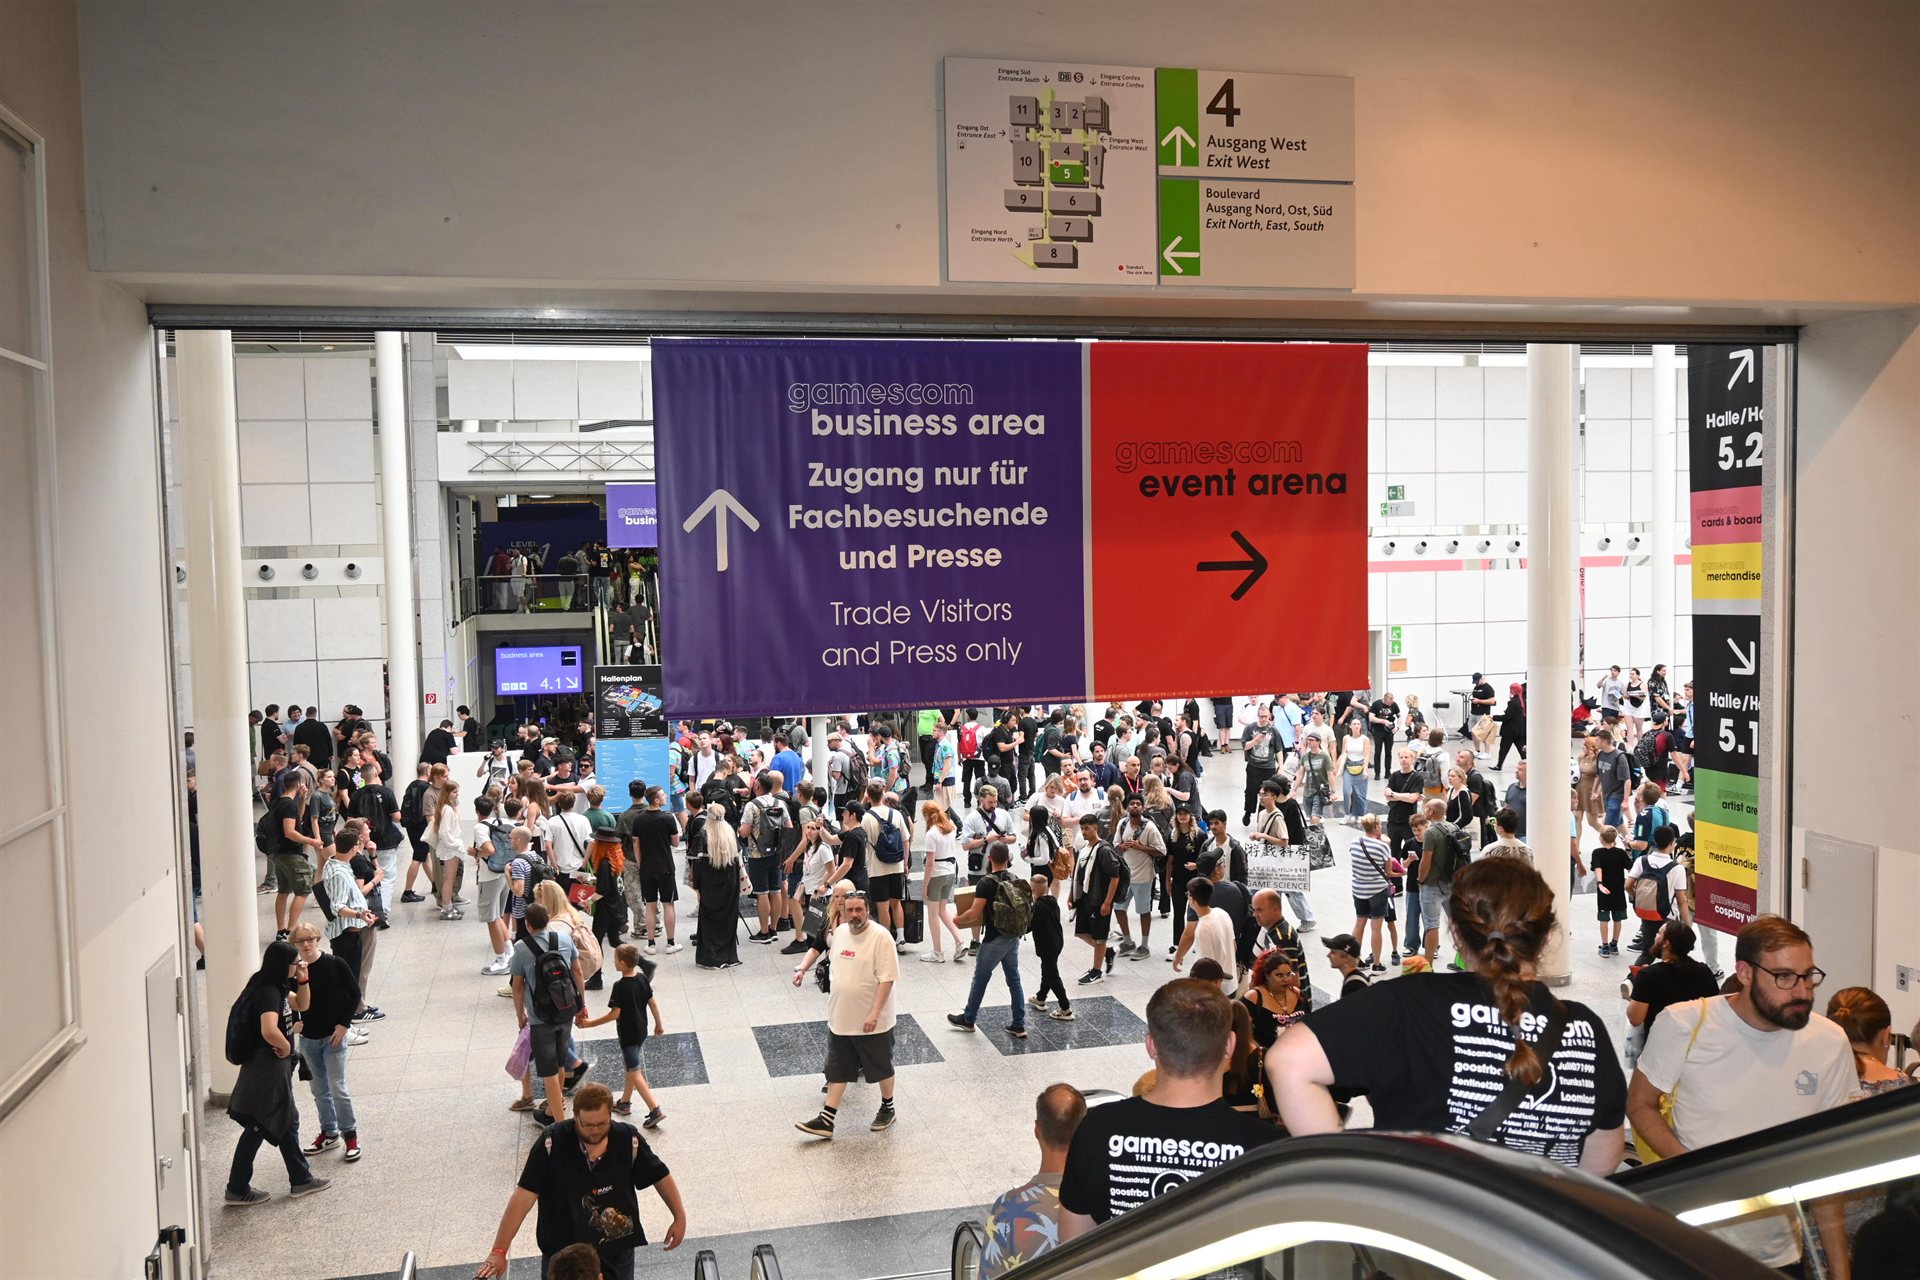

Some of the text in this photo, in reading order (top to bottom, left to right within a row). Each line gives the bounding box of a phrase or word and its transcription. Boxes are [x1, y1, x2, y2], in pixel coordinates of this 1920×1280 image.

[998, 68, 1020, 76] Eingang
[1206, 78, 1241, 127] 4
[1016, 104, 1028, 115] 11
[1055, 108, 1061, 119] 3
[1072, 109, 1079, 119] 2
[957, 124, 979, 132] Eingang
[1207, 135, 1307, 153] Ausgang West
[1064, 146, 1070, 156] 4
[1020, 156, 1032, 166] 10
[1094, 156, 1098, 165] 1
[1207, 154, 1270, 169] Exit West
[1064, 169, 1070, 179] 5
[1020, 194, 1027, 204] 9
[1206, 188, 1260, 200] Boulevard
[1069, 196, 1076, 206] 6
[1206, 203, 1333, 217] Ausgang Nord, Ost, Süd
[1065, 222, 1071, 232] 7
[1206, 219, 1324, 232] Exit North, East, South
[1051, 248, 1057, 258] 8
[788, 382, 974, 413] gamescom
[811, 409, 1046, 436] business area
[1116, 440, 1303, 474] gamescom
[1718, 431, 1763, 470] 5.2
[808, 460, 1028, 493] Zugang nur für
[1139, 468, 1347, 498] event arena
[789, 502, 1049, 529] Fachbesuchende
[1701, 514, 1762, 527] cards & board
[839, 544, 1002, 570] und Presse
[1707, 571, 1761, 581] merchandise
[830, 599, 1012, 626] Trade Visitors
[822, 637, 1022, 667] and Press only
[540, 677, 561, 690] 4.1
[601, 675, 643, 684] Hallenplan
[1710, 692, 1760, 711] Halle/H
[1719, 718, 1758, 755] 5.1
[1722, 801, 1744, 813] artist
[1709, 851, 1758, 871] merchandise
[1273, 881, 1308, 890] SCIENCE
[1714, 905, 1745, 922] cosplay
[1487, 1025, 1508, 1036] THE
[1108, 1134, 1244, 1160] gamescom
[1135, 1153, 1152, 1162] THE
[1156, 1155, 1180, 1165] 2025
